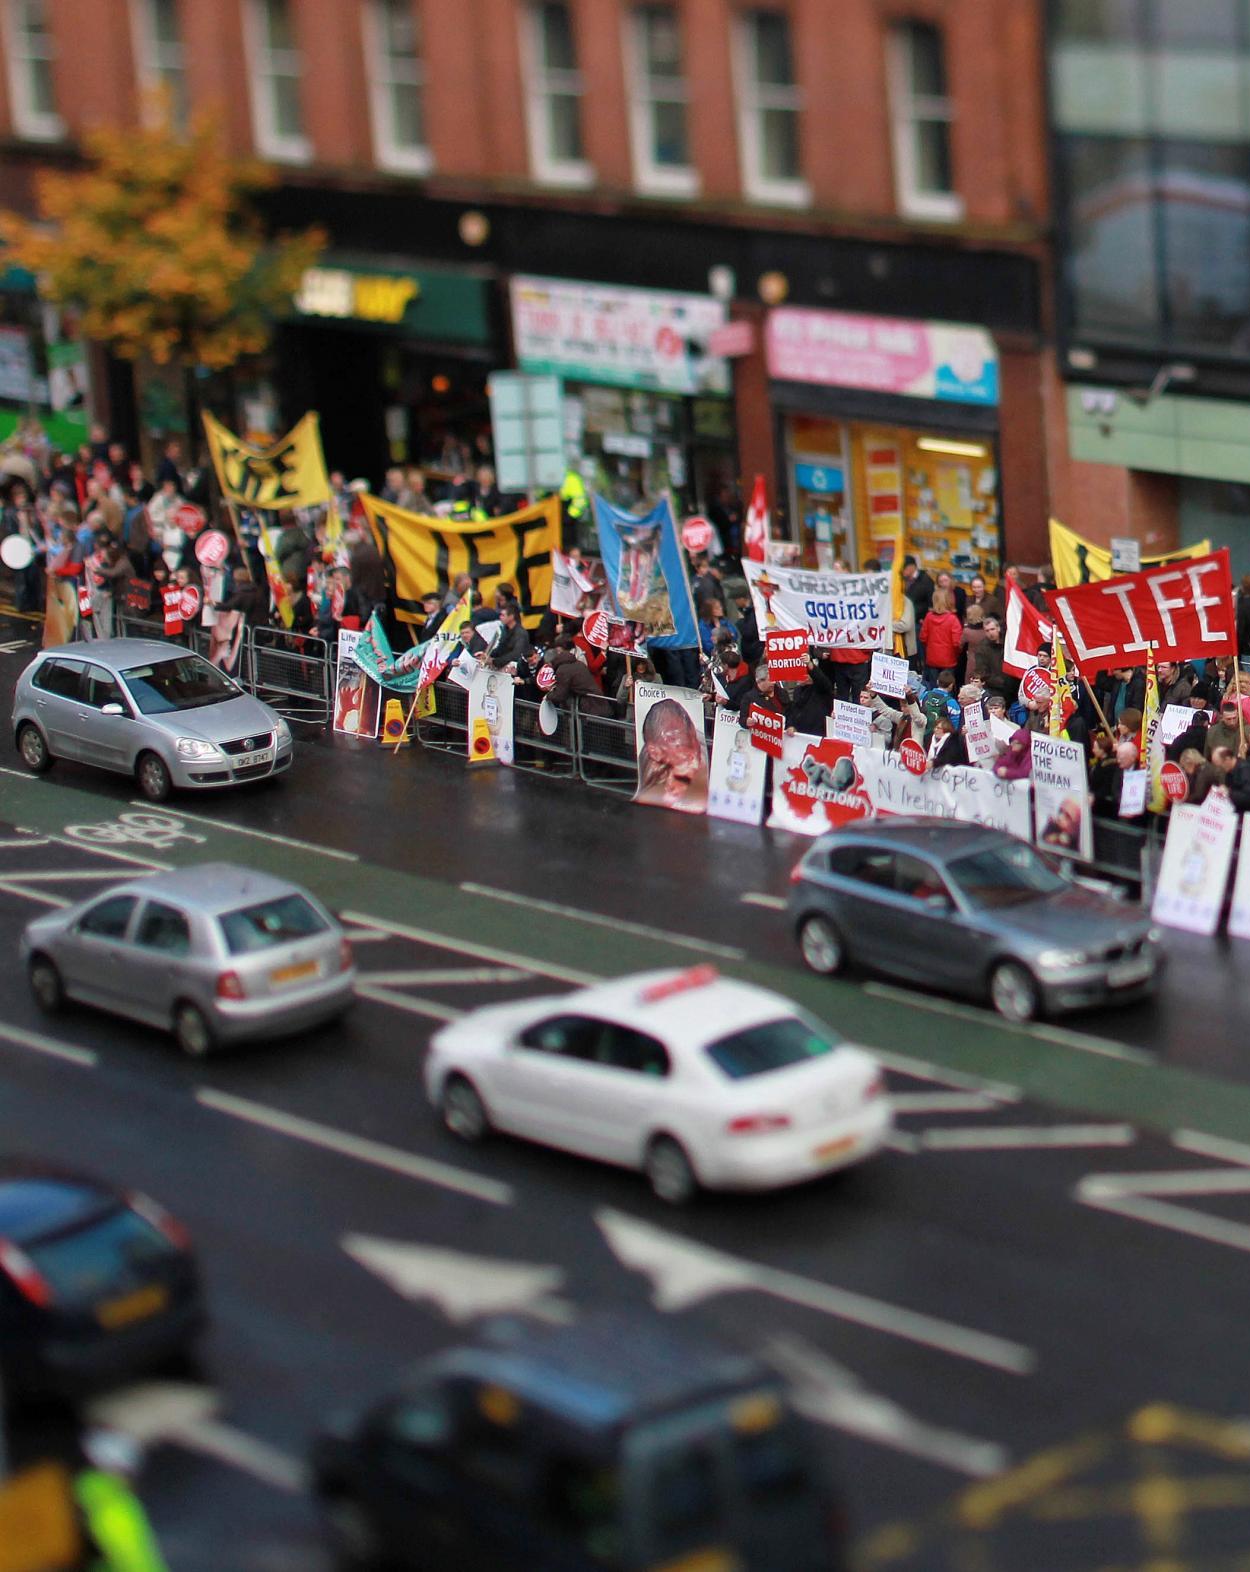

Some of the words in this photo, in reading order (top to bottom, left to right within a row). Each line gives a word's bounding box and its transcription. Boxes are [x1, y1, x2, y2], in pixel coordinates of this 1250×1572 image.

[805, 599, 879, 629] against
[1056, 561, 1228, 661] LIFE
[768, 636, 803, 651] STOP
[882, 668, 895, 681] KILL
[638, 687, 660, 699] Choice
[660, 689, 666, 699] is
[720, 713, 736, 723] STOP
[841, 703, 857, 714] Protect
[751, 710, 781, 730] STOP
[969, 719, 978, 728] THE
[751, 728, 783, 748] ABORTION
[901, 742, 926, 764] PROTECT
[1033, 739, 1079, 761] PROTECT
[906, 755, 922, 771] LIFE
[1033, 755, 1053, 770] THE
[1034, 770, 1071, 789] HUMAN
[788, 780, 863, 809] ABORTION?
[877, 778, 892, 801] N
